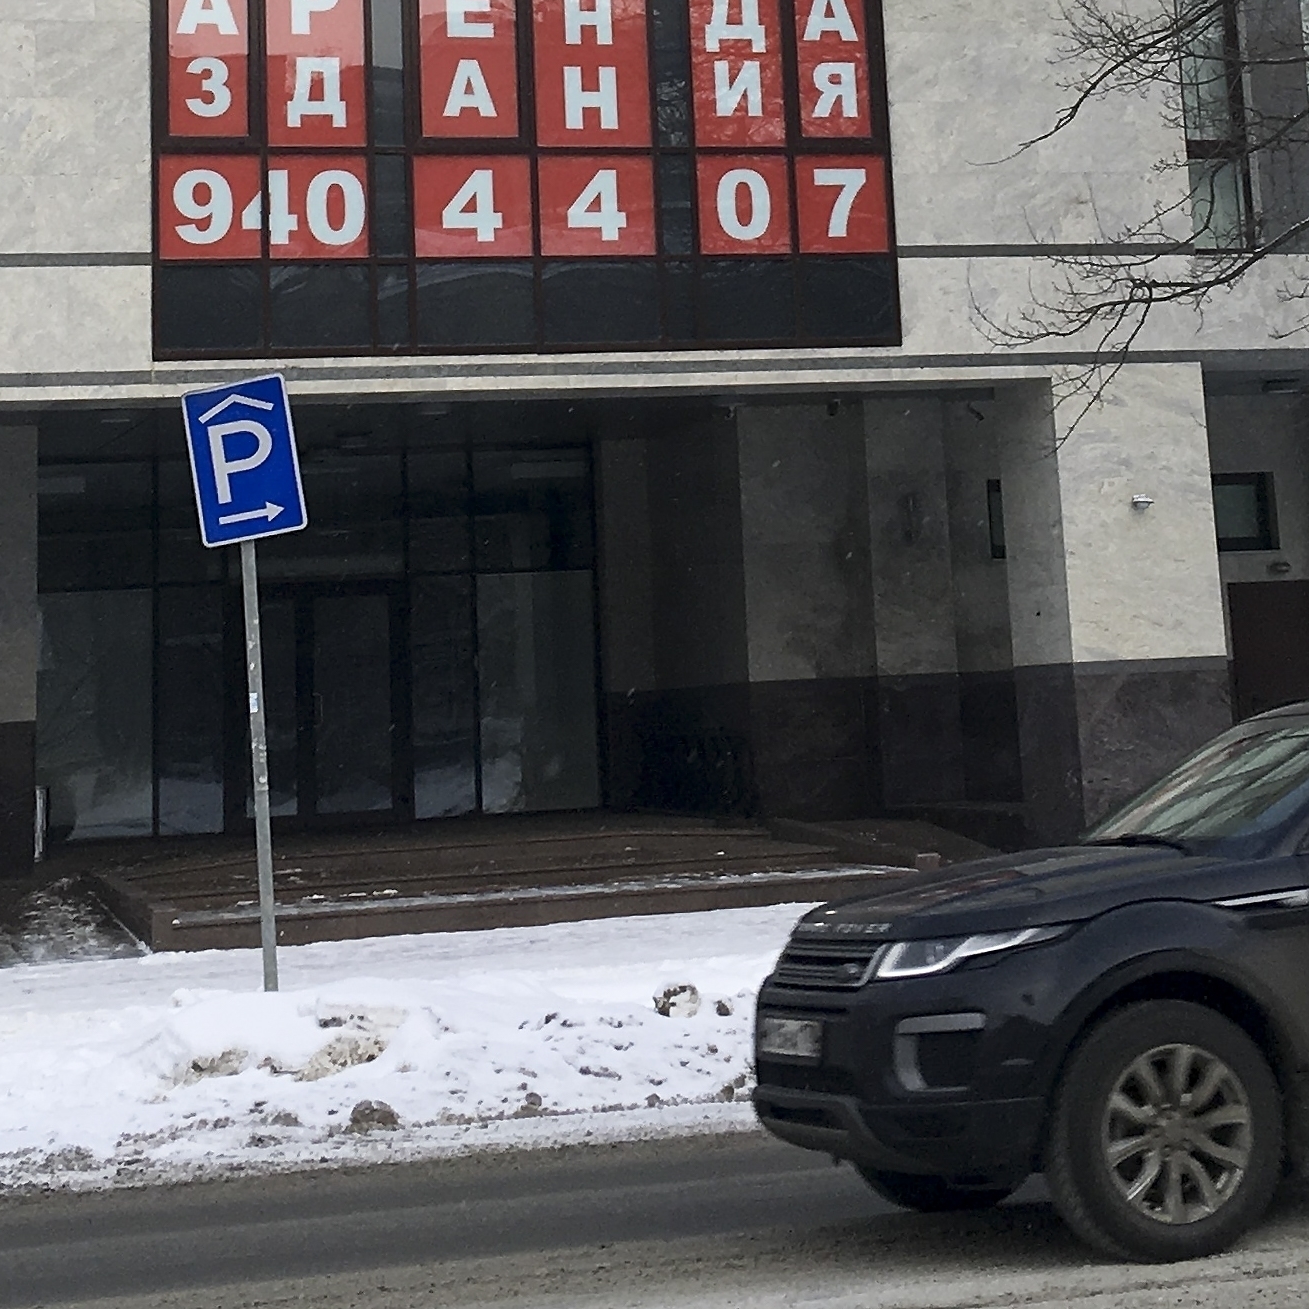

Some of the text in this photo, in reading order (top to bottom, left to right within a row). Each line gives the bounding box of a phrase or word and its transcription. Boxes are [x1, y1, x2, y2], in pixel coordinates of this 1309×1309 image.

[185, 56, 860, 130] ЗДАНИЯ
[173, 168, 867, 246] 940 44 07
[207, 419, 273, 505] P
